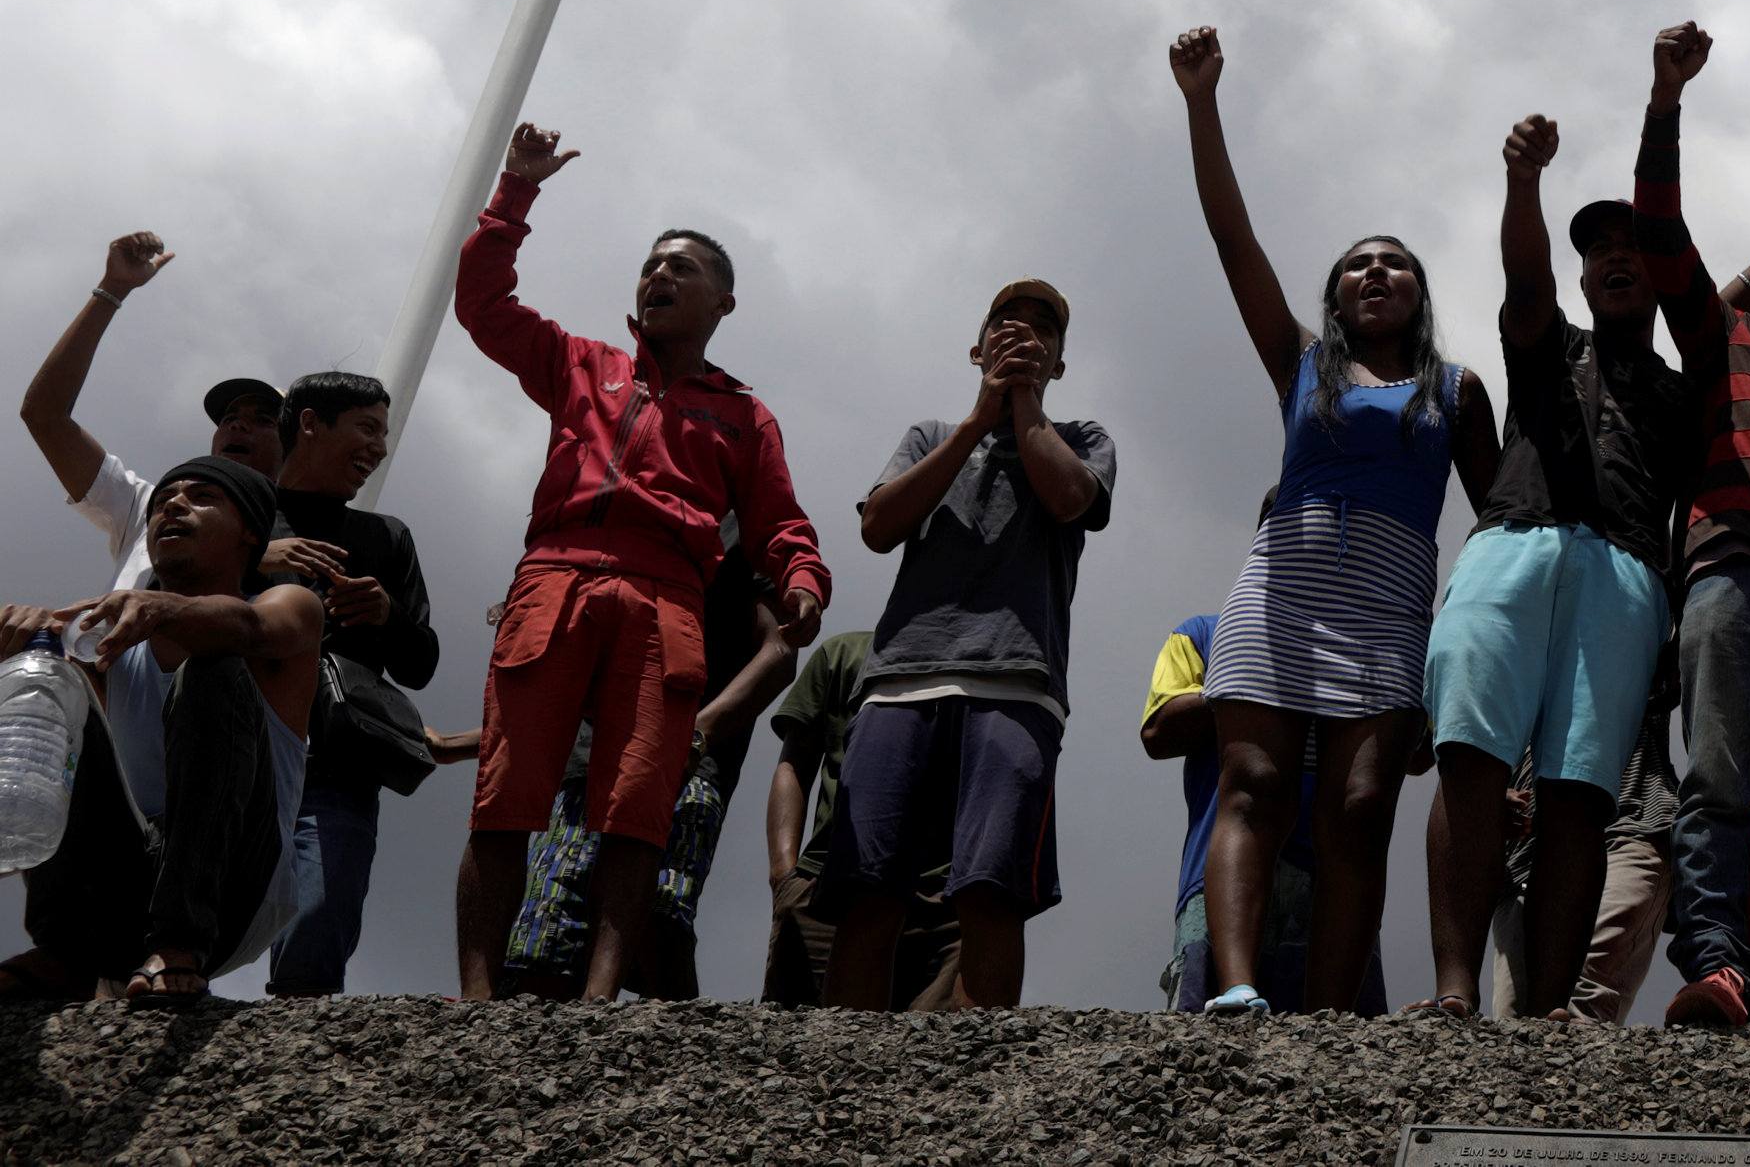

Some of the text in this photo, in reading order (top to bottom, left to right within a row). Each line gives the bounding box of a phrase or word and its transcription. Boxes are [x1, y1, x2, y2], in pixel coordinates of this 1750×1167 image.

[1460, 1146, 1484, 1157] EM
[1488, 1147, 1508, 1158] 20
[1513, 1148, 1533, 1158] DE
[1536, 1149, 1584, 1160] JULHO
[1589, 1150, 1609, 1161] DE
[1657, 1152, 1737, 1165] FERNANDO
